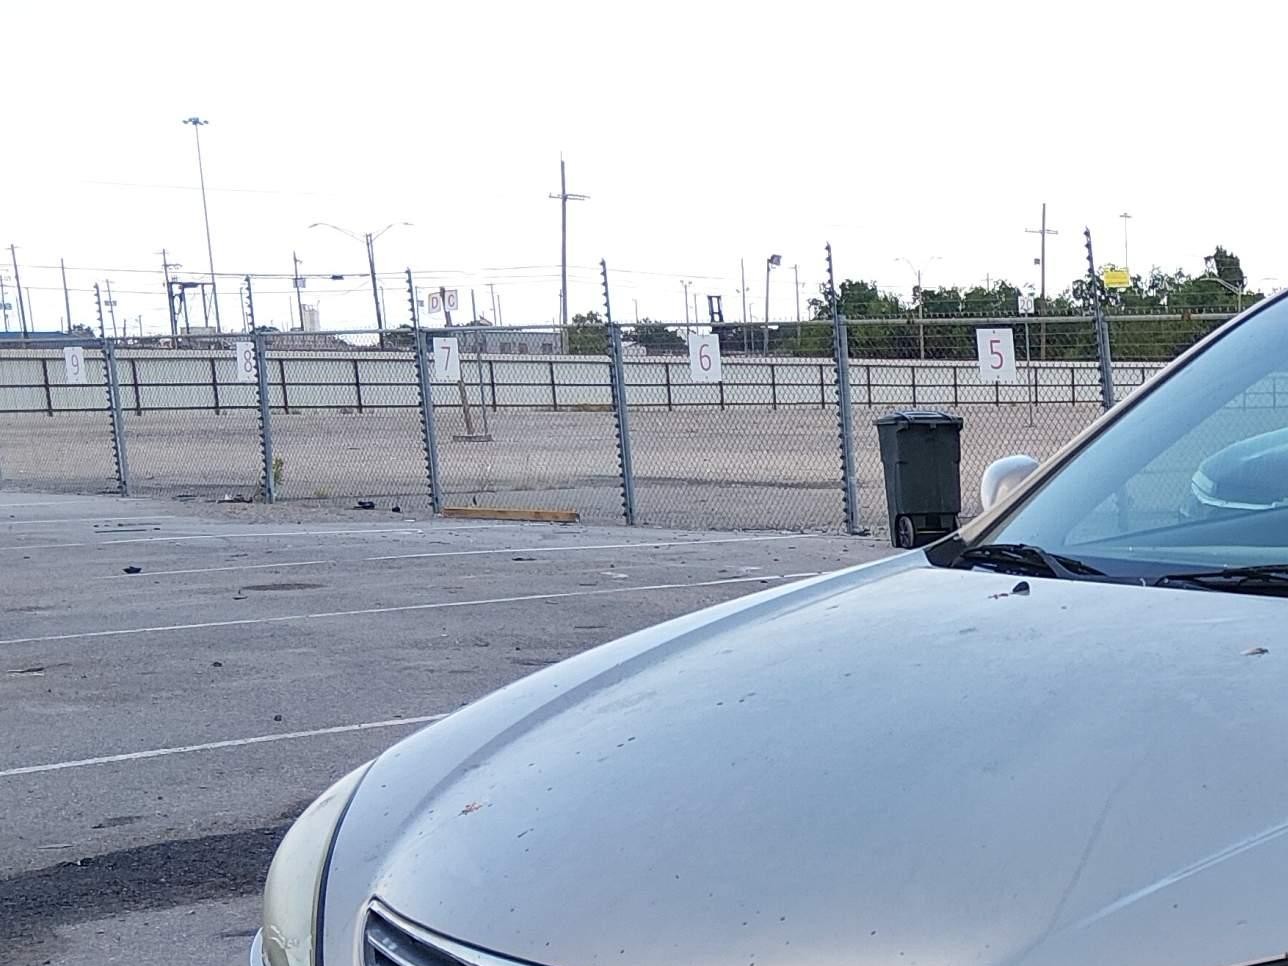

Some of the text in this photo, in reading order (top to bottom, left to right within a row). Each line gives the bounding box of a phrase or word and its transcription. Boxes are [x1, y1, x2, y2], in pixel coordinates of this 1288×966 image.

[447, 295, 455, 308] C
[71, 354, 79, 375] 9
[243, 350, 252, 373] 8
[440, 346, 451, 371] 7
[699, 343, 711, 372] 6
[990, 339, 1003, 370] 5
